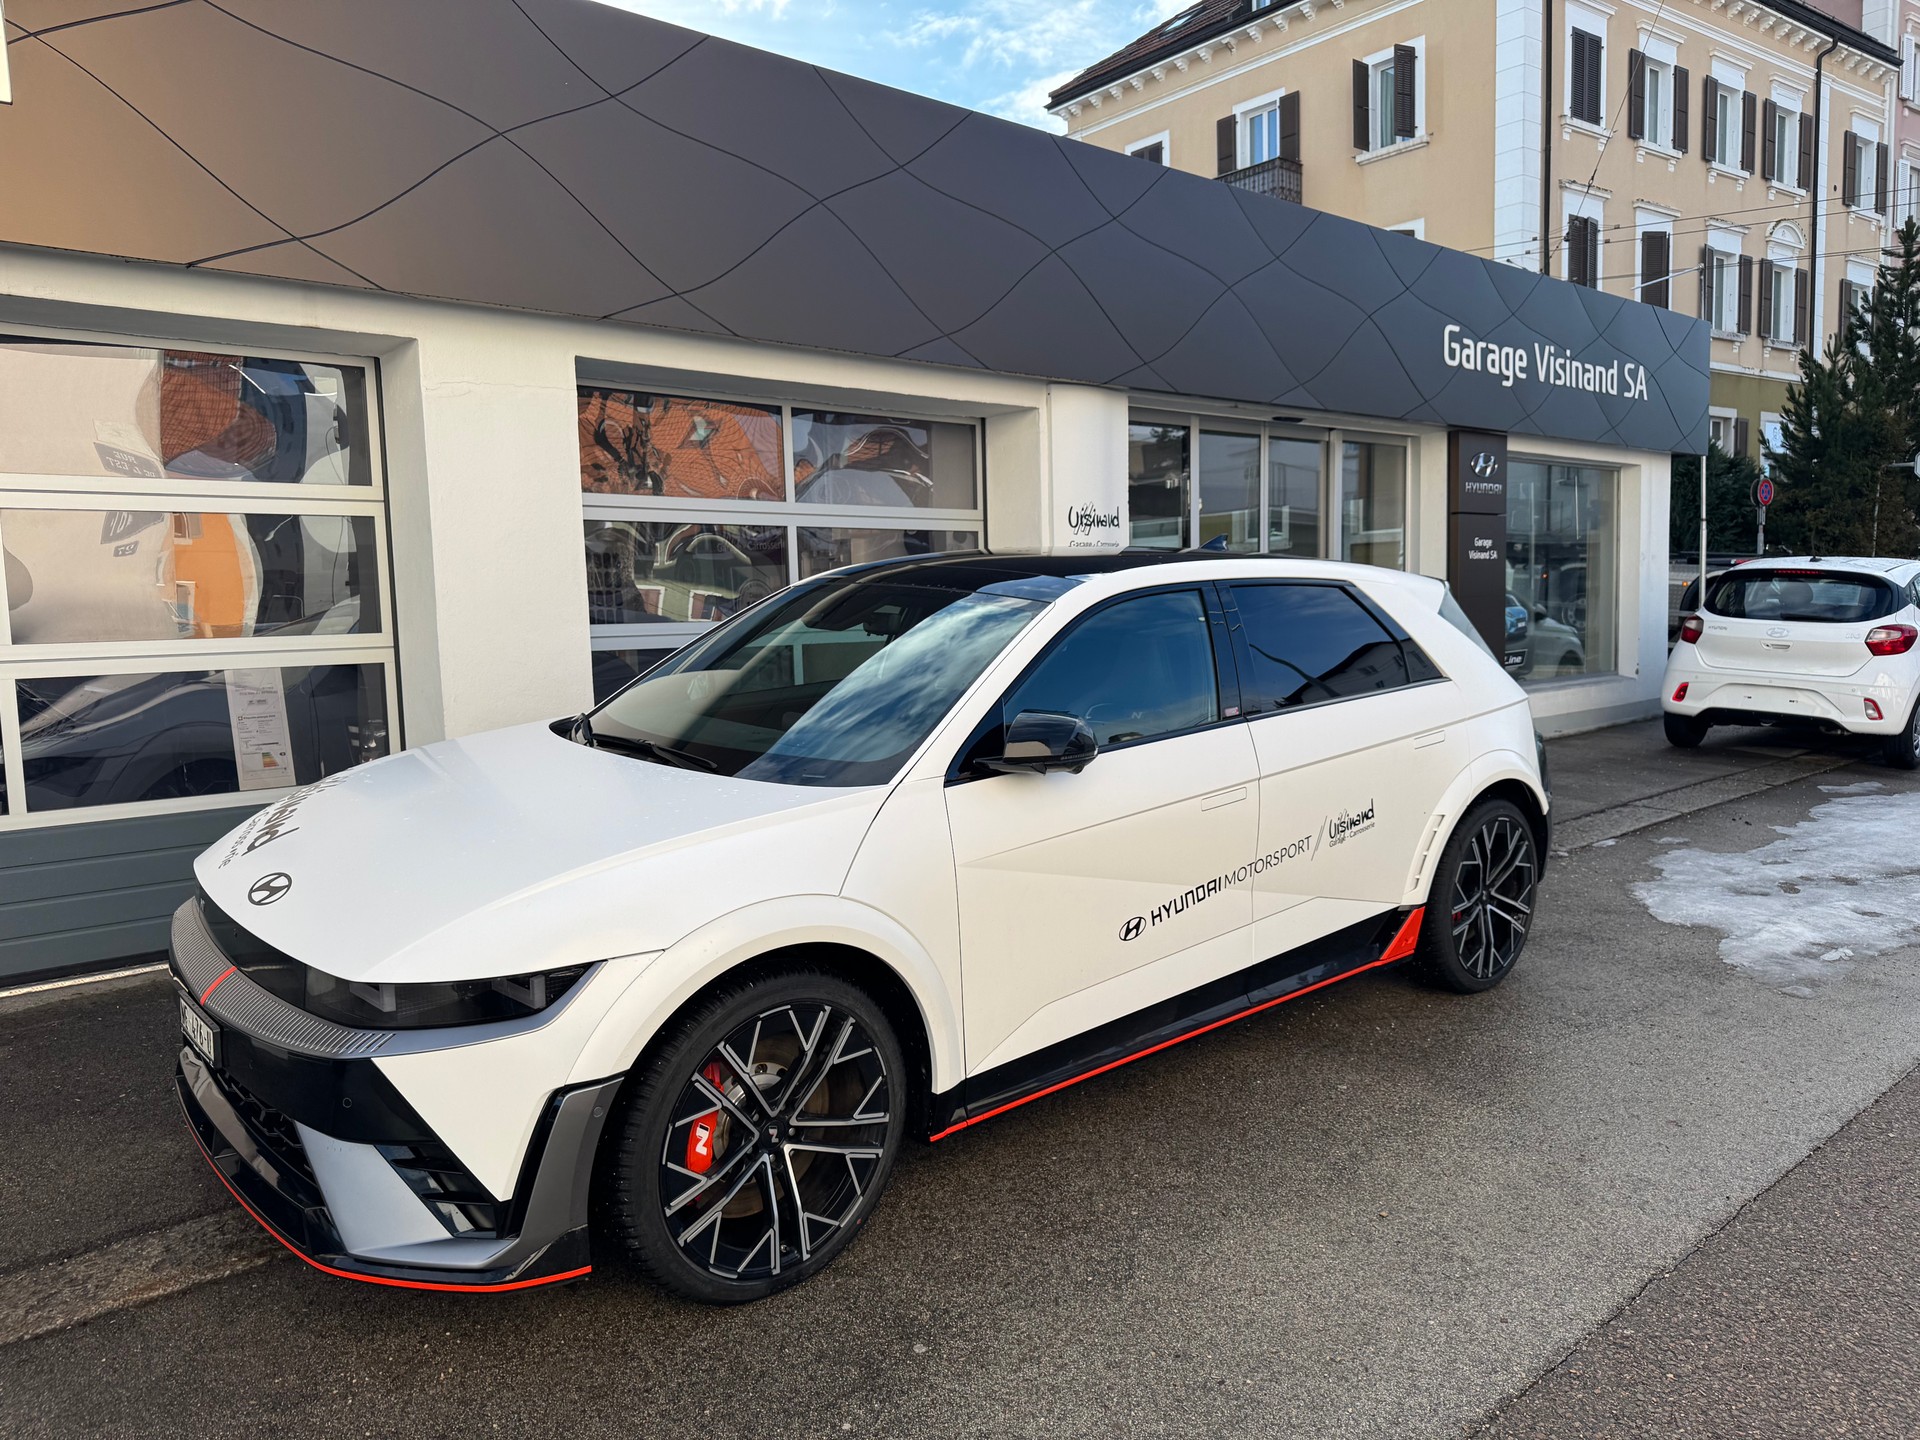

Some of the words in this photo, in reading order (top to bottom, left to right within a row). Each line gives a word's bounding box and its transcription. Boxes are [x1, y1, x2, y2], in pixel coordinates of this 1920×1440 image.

[1443, 324, 1527, 387] Garage
[1534, 342, 1618, 396] Visinand
[1623, 362, 1648, 401] SA
[1465, 481, 1502, 494] HYUNDAI
[1474, 537, 1493, 549] Garage
[1468, 550, 1490, 559] Visinand
[1490, 550, 1498, 559] SA
[1150, 876, 1222, 927] HYUNDAI
[1223, 834, 1312, 889] MOTORSPORT
